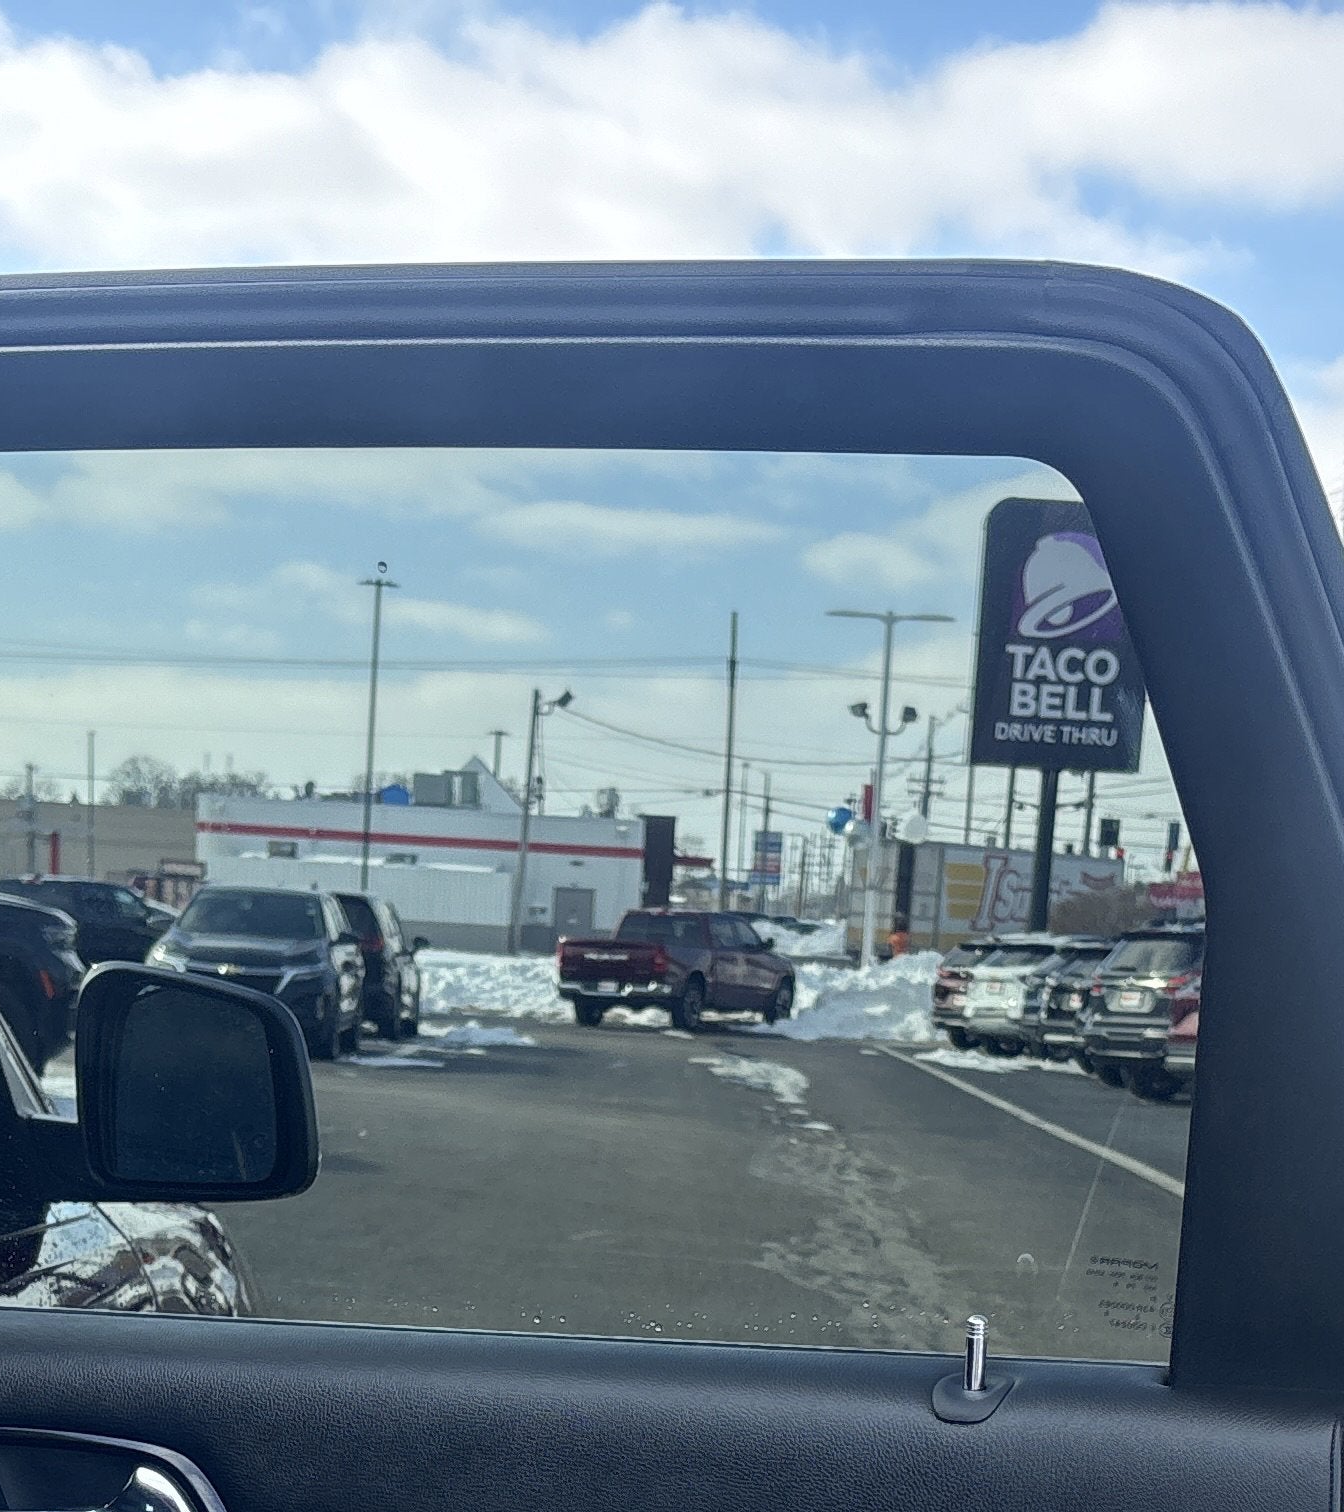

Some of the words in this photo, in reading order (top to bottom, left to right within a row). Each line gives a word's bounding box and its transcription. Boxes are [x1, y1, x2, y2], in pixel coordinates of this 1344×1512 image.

[1004, 644, 1120, 686] TACO
[1009, 681, 1115, 722] BELL
[994, 721, 1058, 744] DRIVE
[1059, 725, 1118, 747] THRU
